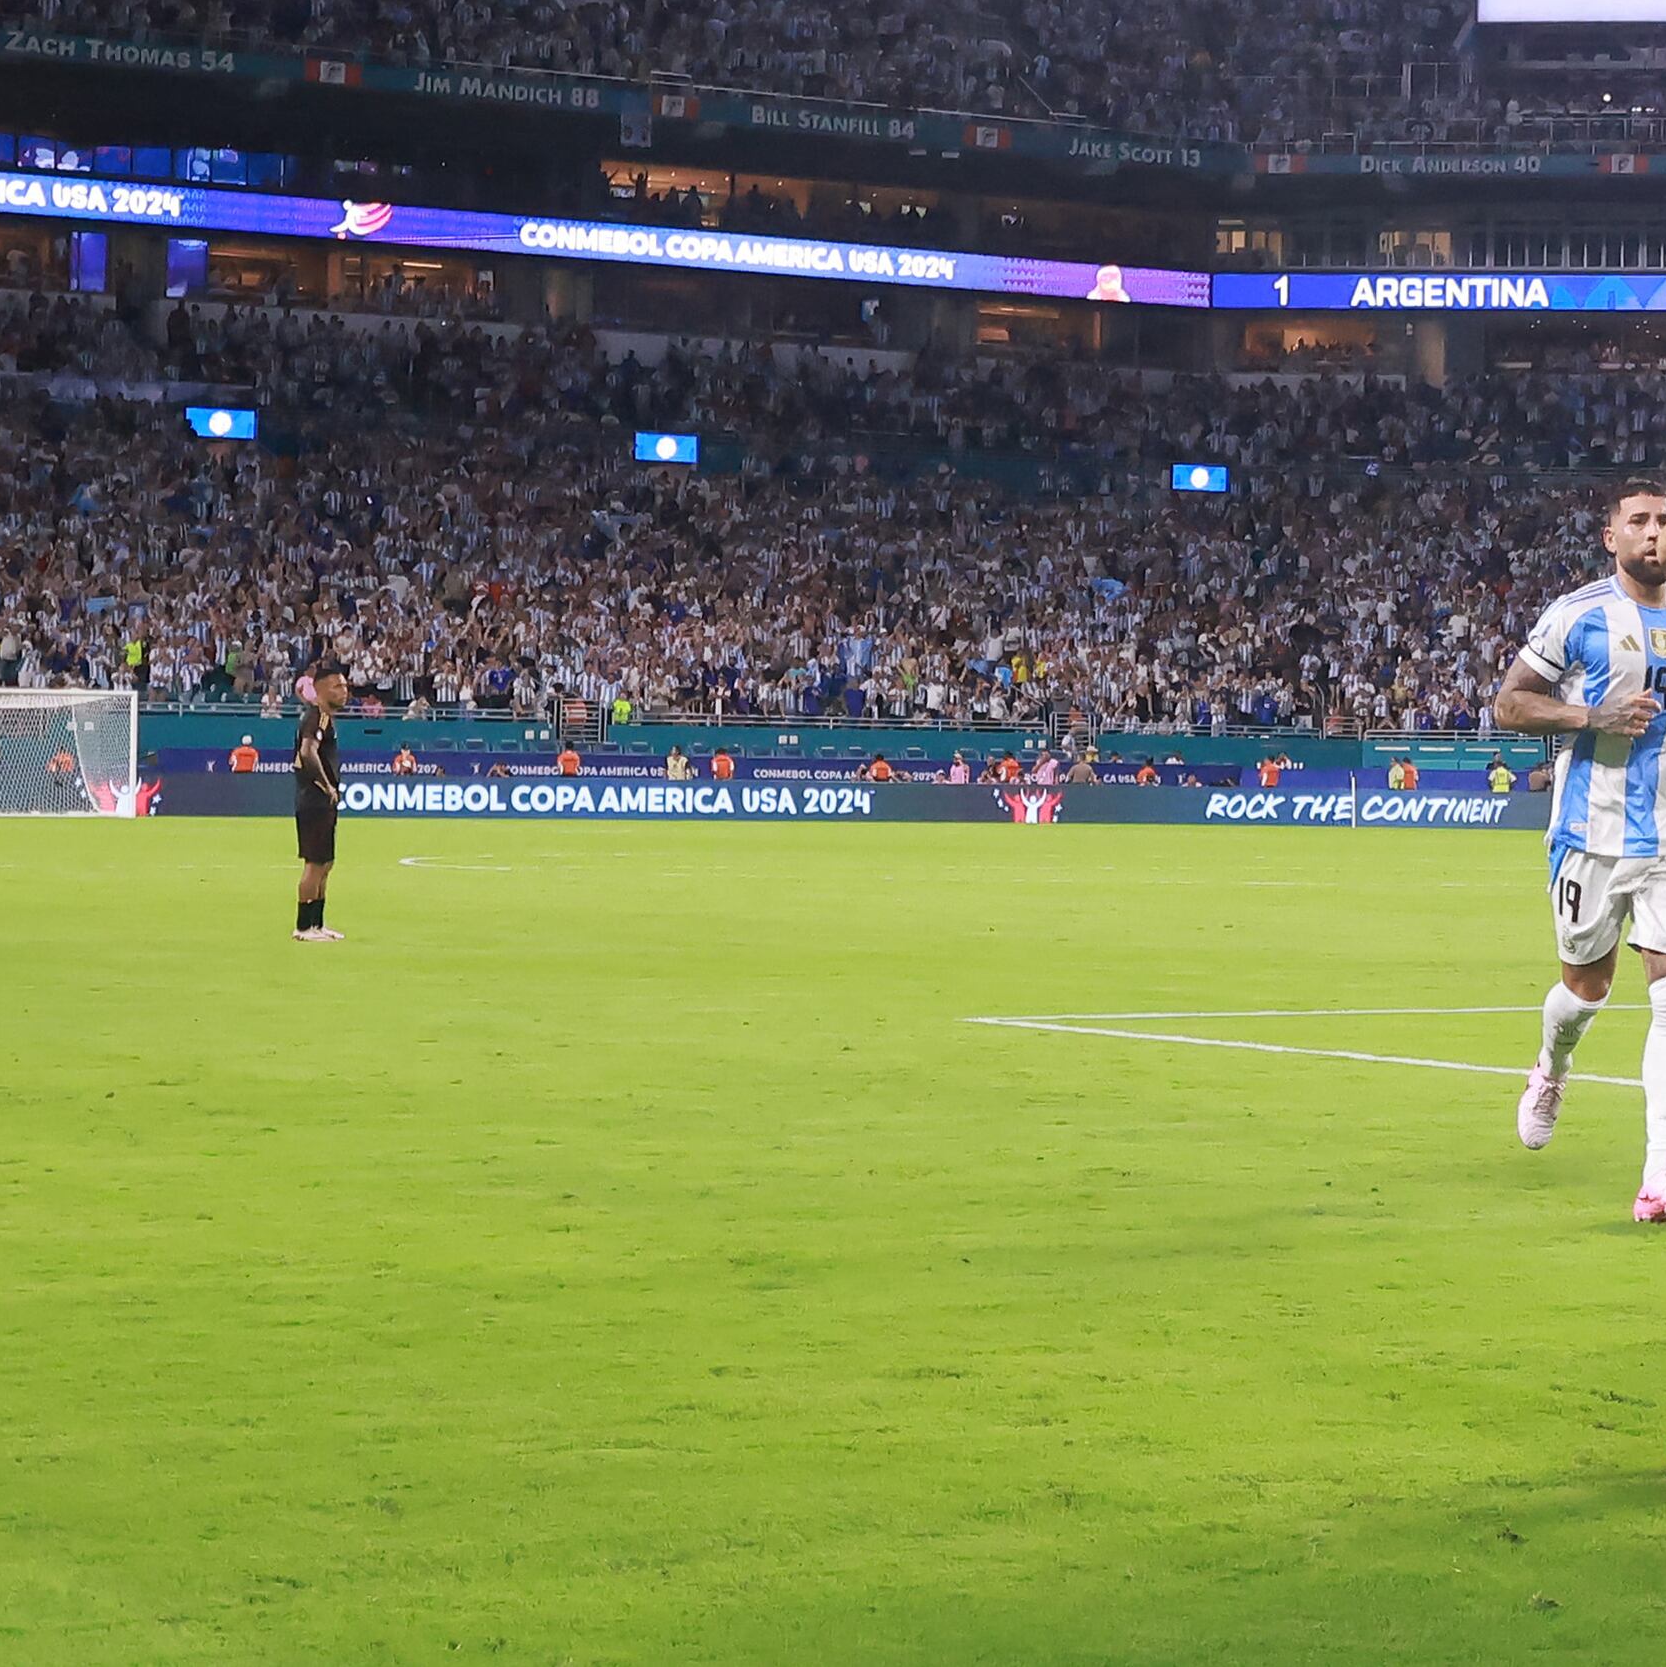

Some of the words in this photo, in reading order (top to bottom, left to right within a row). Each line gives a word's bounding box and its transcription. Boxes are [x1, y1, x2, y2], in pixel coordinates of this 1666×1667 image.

[5, 30, 76, 57] ZACH
[85, 38, 192, 69] THOMAS
[201, 50, 236, 73] 54
[414, 72, 451, 95] JIM
[459, 76, 563, 105] MANDICH
[570, 87, 600, 109] 88
[751, 105, 790, 127] BILL
[797, 109, 880, 136] STANFILL
[889, 119, 916, 140] 84
[1068, 137, 1111, 158] JAKE
[1118, 142, 1172, 165] SCOTT
[1180, 148, 1201, 168] 13
[1360, 154, 1403, 174] DICK
[1411, 155, 1507, 174] ANDERSON
[1513, 155, 1542, 174] 40
[52, 182, 108, 213] USA
[112, 188, 181, 218] 2024
[519, 222, 664, 258] CONMEBOL
[665, 234, 735, 263] COPA
[734, 238, 843, 272] AMERICA
[848, 250, 894, 277] USA
[898, 254, 955, 281] 2024
[1272, 275, 1289, 306] 1
[1350, 276, 1550, 308] ARGENTINA
[339, 763, 393, 774] AMERICA
[599, 767, 649, 777] AMERICA
[753, 768, 813, 780] CONMEBOL
[814, 770, 842, 781] COPA
[510, 784, 596, 813] COPA
[598, 785, 735, 814] AMERICA
[741, 786, 797, 815] USA
[803, 787, 871, 815] 2024
[1205, 793, 1286, 821] ROCK
[1292, 795, 1354, 822] THE
[1361, 796, 1510, 824] CONTINENT
[1558, 876, 1582, 924] 19
